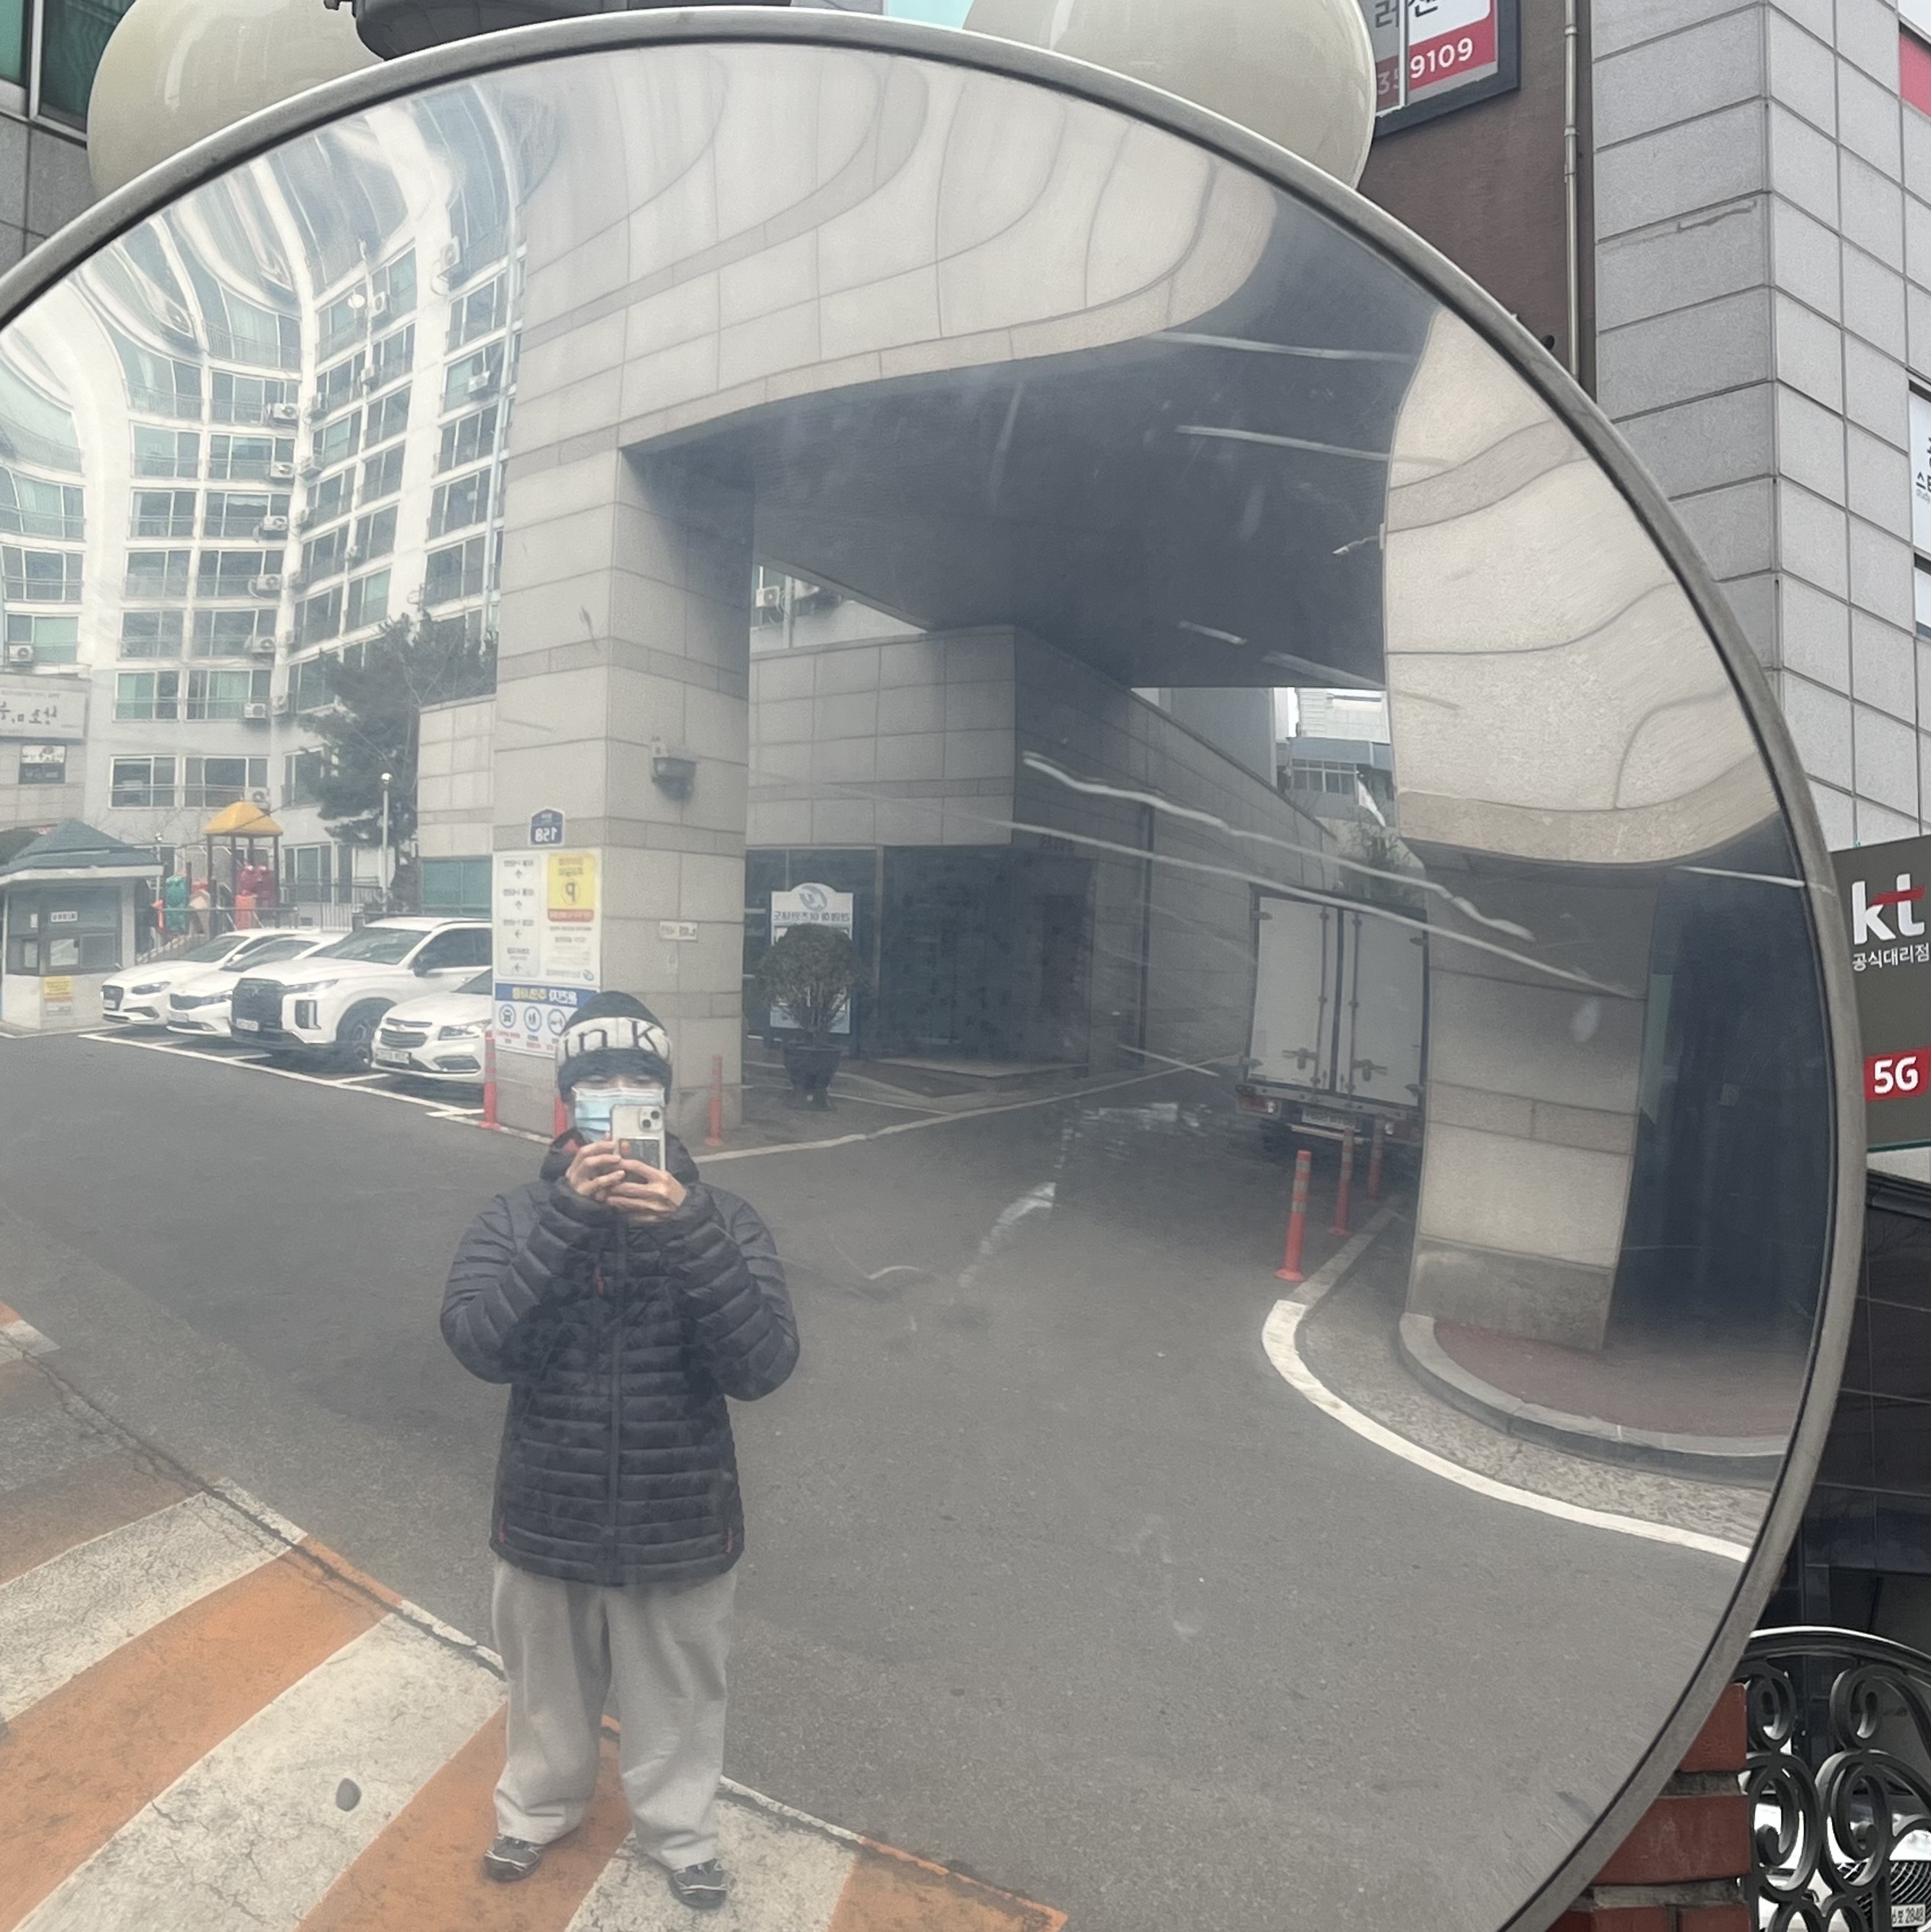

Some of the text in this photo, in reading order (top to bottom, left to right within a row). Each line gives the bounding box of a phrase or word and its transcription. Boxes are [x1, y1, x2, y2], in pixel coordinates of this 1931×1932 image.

[1410, 38, 1474, 79] 9109
[1852, 874, 1925, 945] kt
[1852, 942, 1930, 971] 공식대리점
[1875, 1056, 1919, 1094] 5G
